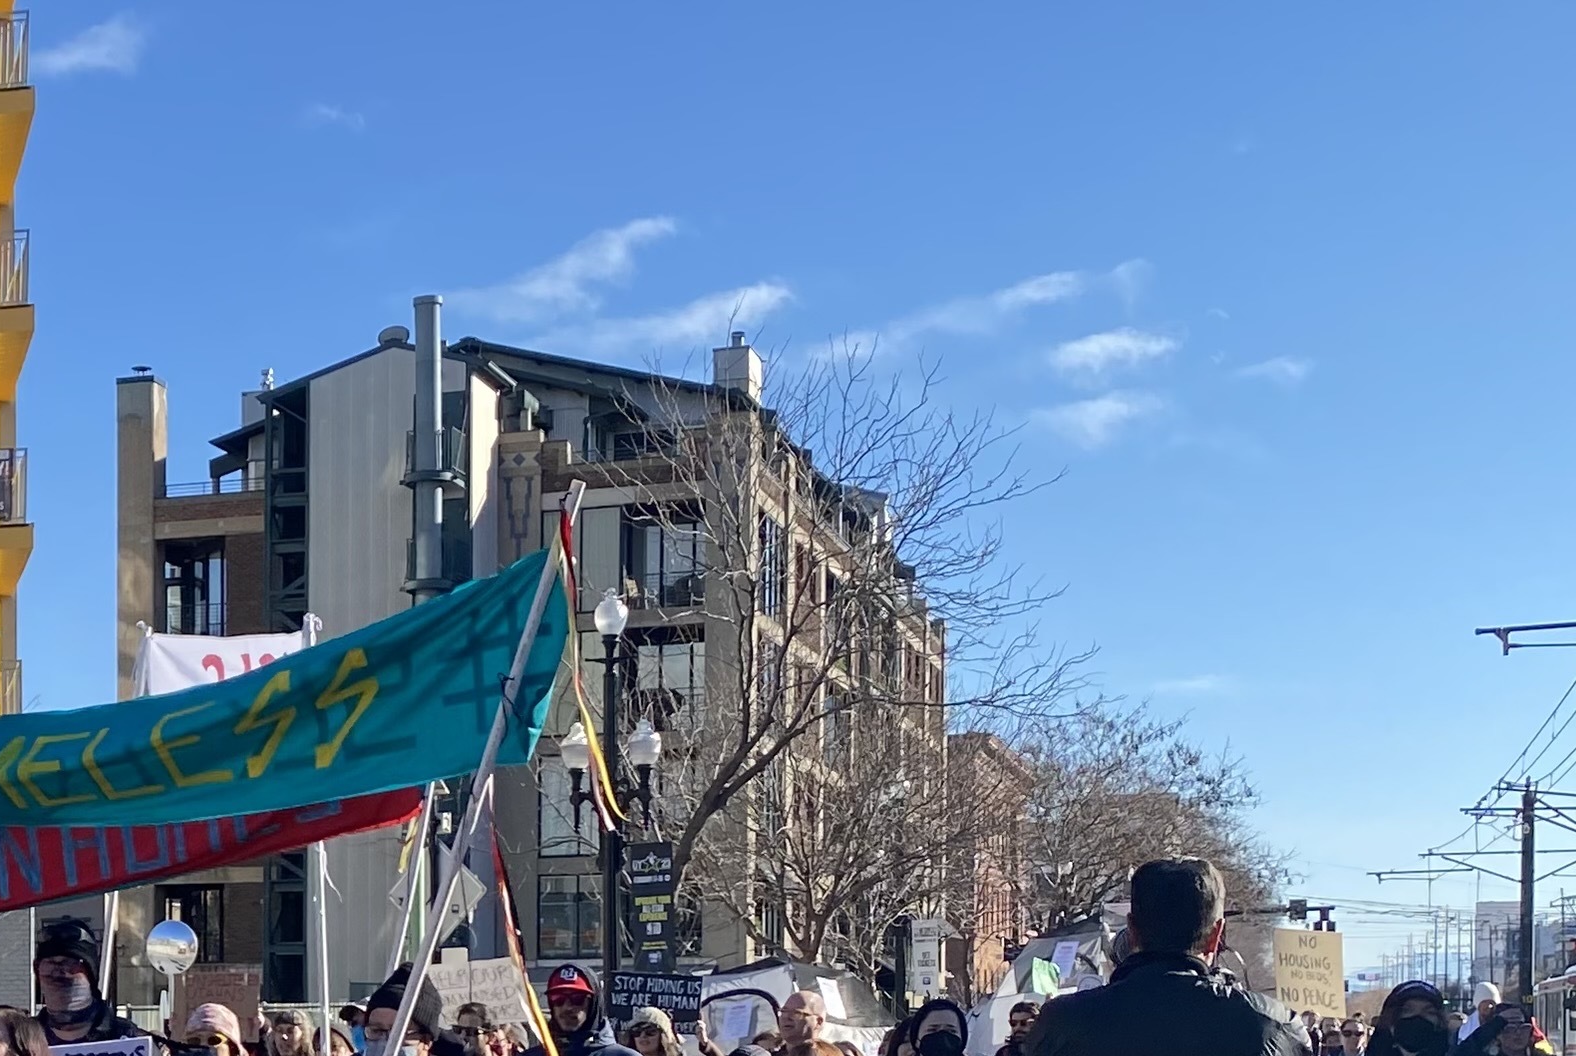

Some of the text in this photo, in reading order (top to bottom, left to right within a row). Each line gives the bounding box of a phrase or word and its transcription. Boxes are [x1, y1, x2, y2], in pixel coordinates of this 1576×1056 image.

[1299, 934, 1317, 949] NO
[1291, 969, 1303, 980] NO
[615, 975, 702, 995] STOP HIDING US
[611, 992, 699, 1010] WE ARE HUMAN
[1281, 986, 1299, 1002] NO
